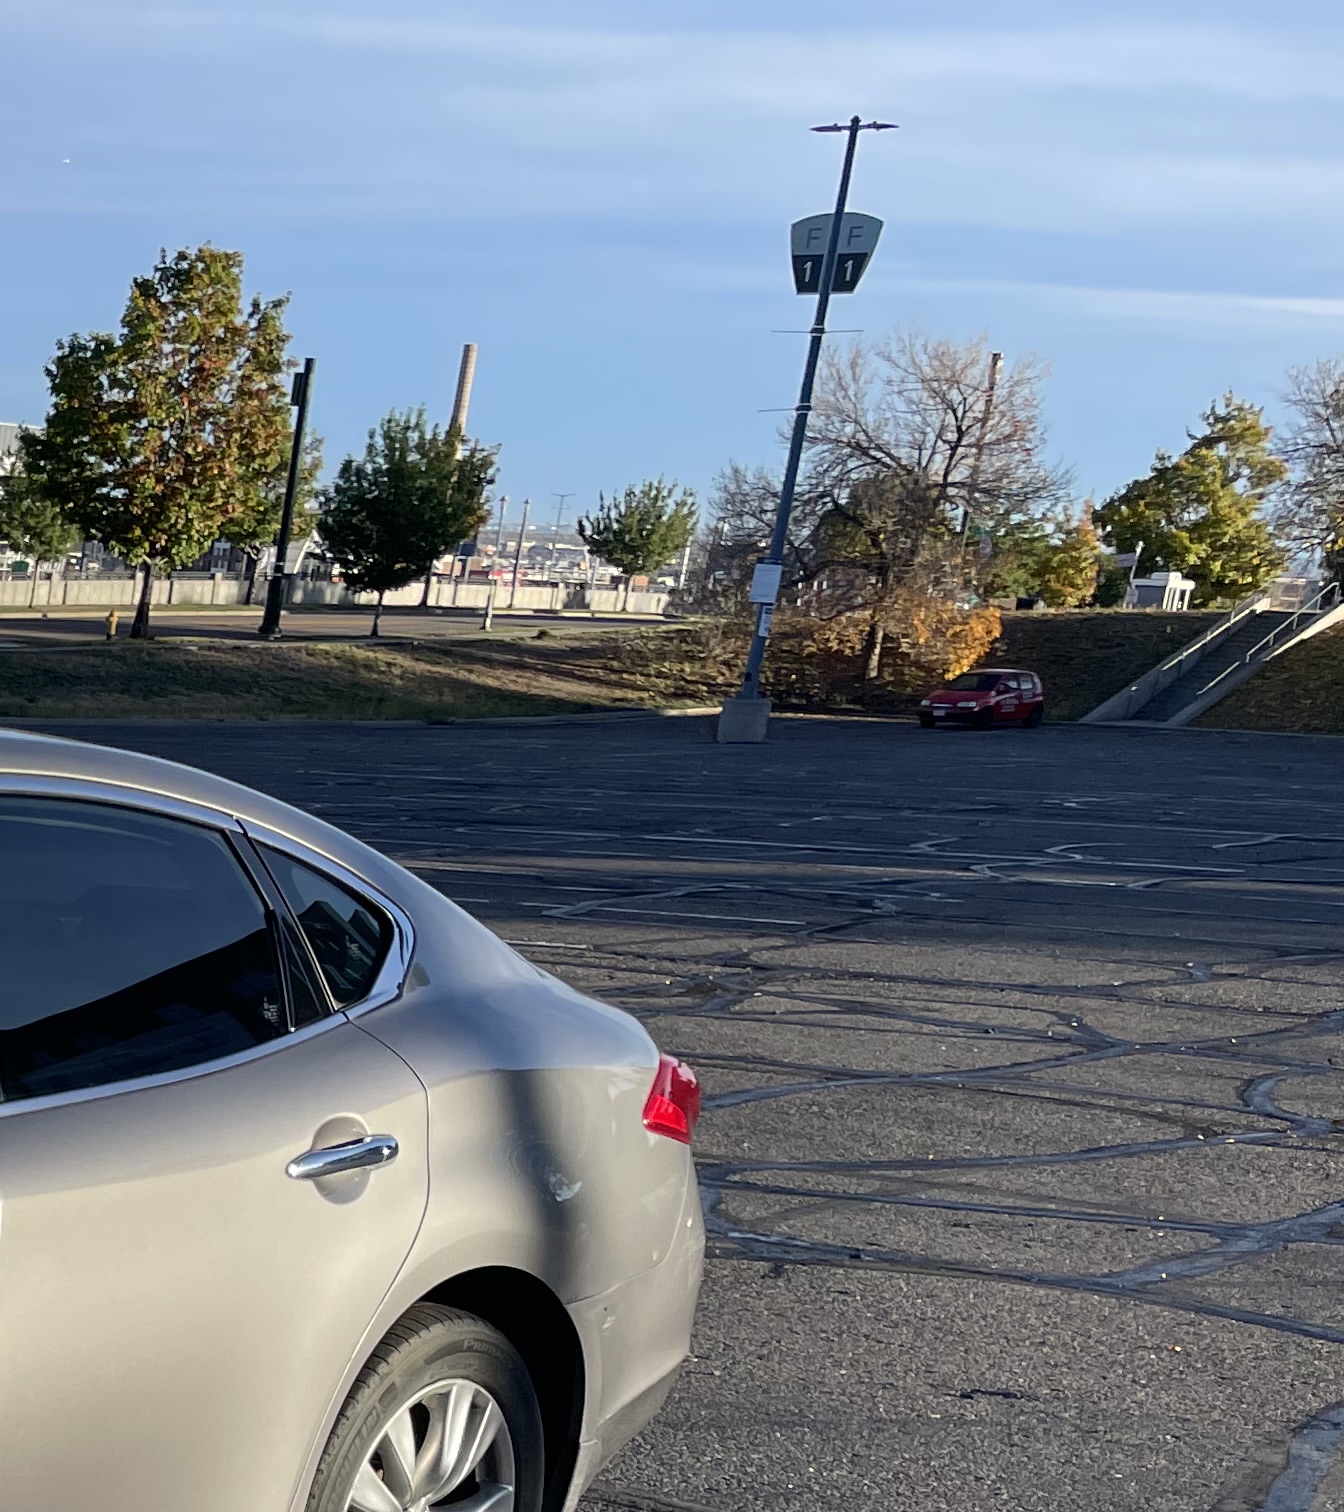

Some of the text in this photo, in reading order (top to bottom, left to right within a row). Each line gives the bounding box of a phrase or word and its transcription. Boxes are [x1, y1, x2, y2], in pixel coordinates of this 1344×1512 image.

[806, 225, 864, 249] F F
[803, 259, 854, 283] 1 1
